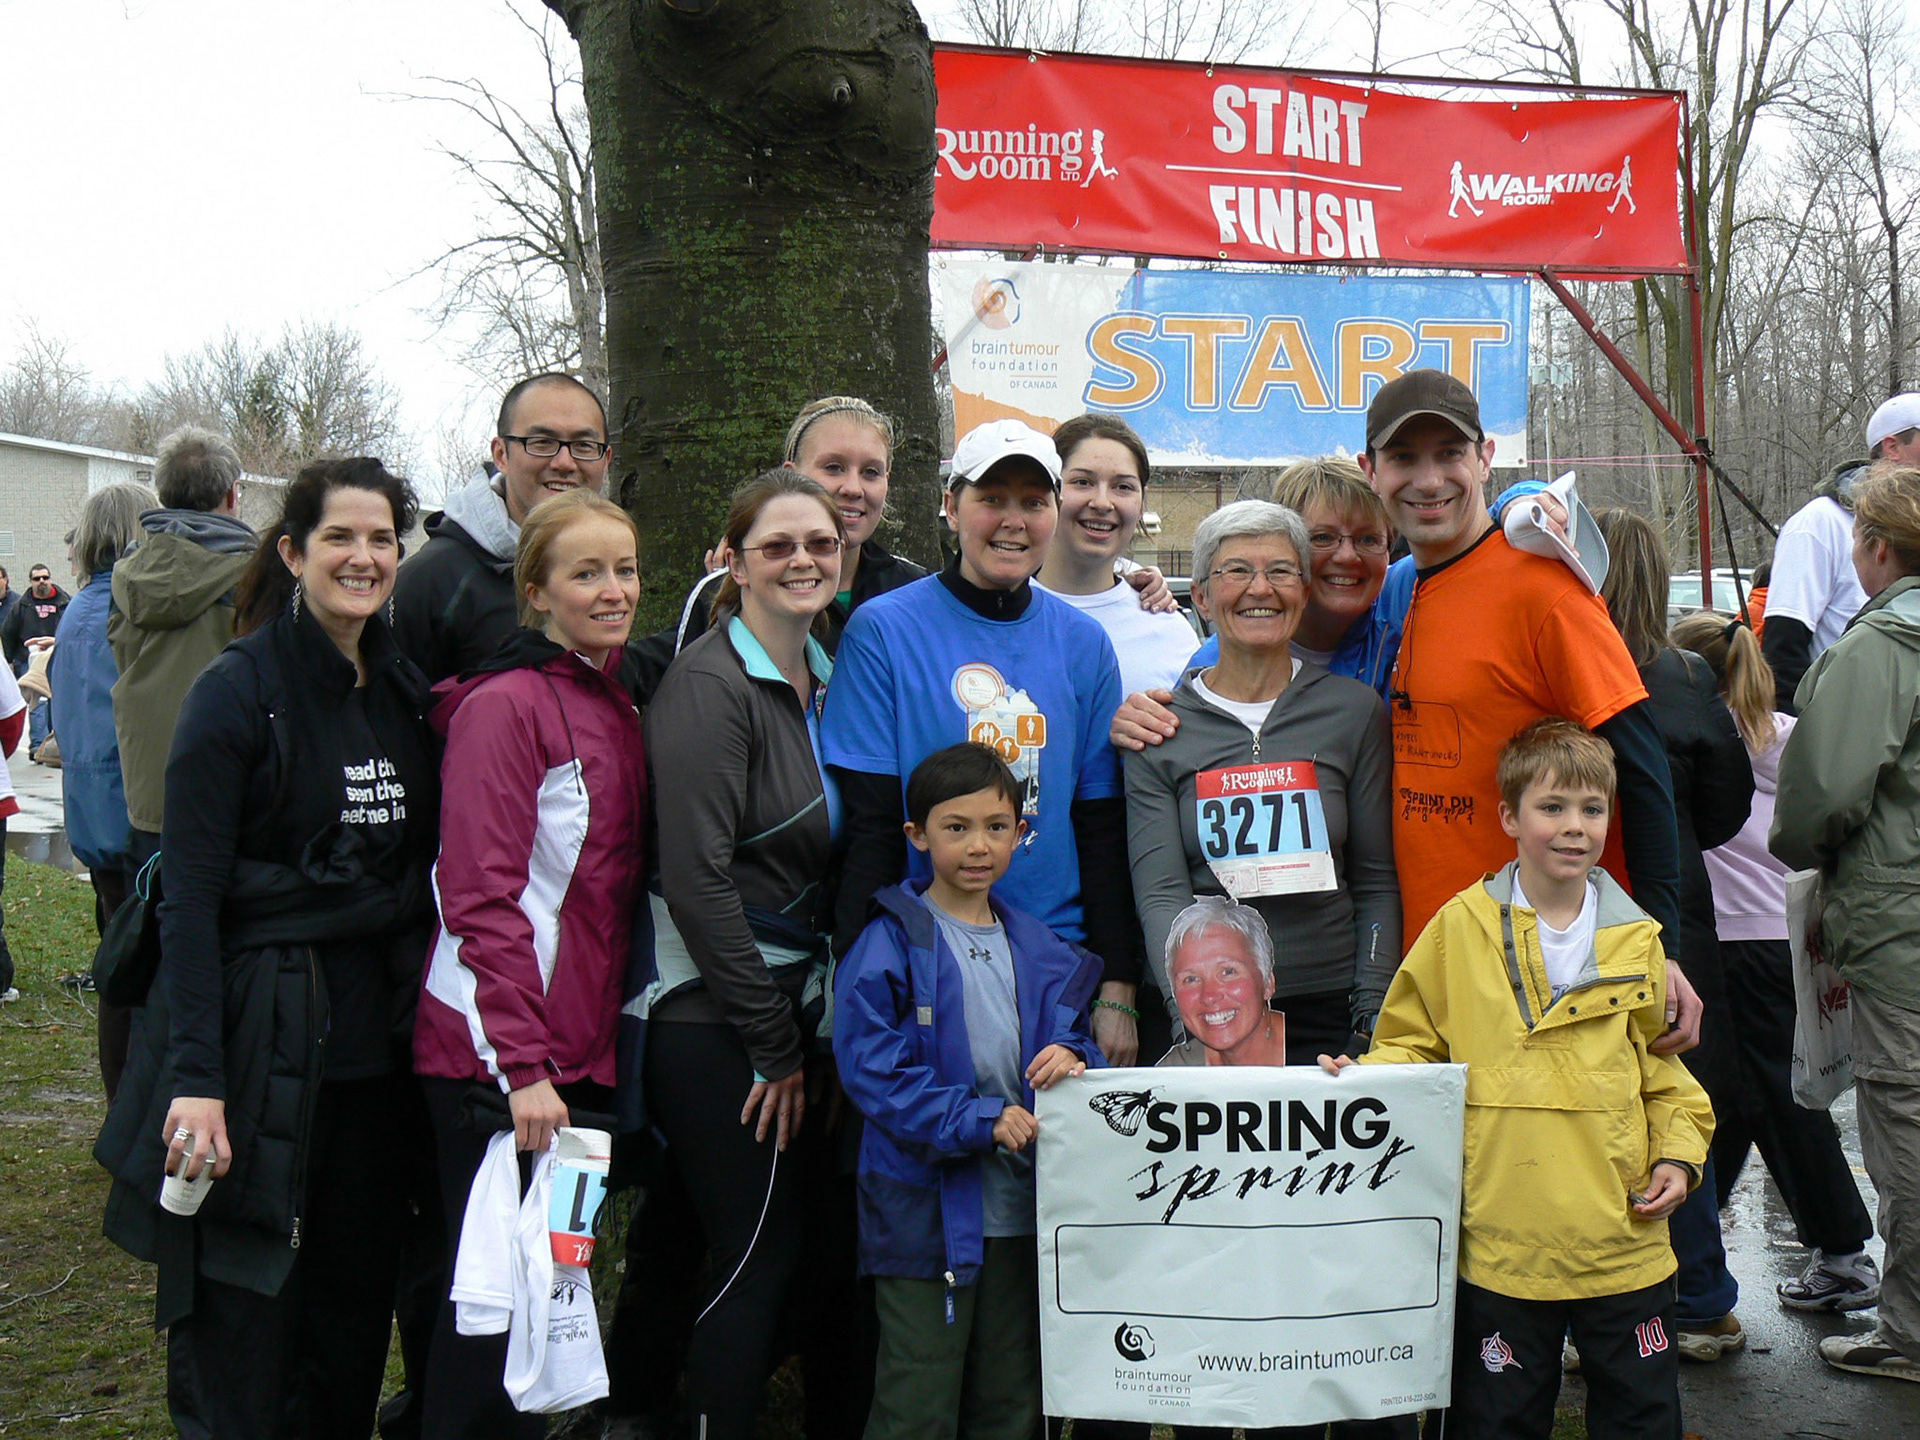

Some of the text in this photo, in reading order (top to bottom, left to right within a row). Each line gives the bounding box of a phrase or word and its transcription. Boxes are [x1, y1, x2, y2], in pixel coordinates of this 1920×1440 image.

[1212, 84, 1369, 167] START
[1468, 172, 1615, 201] WALKING
[1502, 193, 1552, 206] ROOM
[1209, 184, 1381, 259] FINISH
[972, 358, 1058, 371] foundation
[1082, 310, 1512, 413] START
[1009, 380, 1058, 389] OF CANADA
[377, 757, 397, 778] th
[1229, 767, 1285, 790] Running
[376, 779, 406, 801] the
[1407, 791, 1474, 809] SPRINT DU
[340, 804, 367, 824] eet
[392, 800, 406, 821] in
[1203, 792, 1312, 859] 3271
[1145, 1097, 1391, 1153] SPRING
[1128, 1136, 1415, 1225] sprint
[1634, 1316, 1669, 1358] 10
[1198, 1343, 1415, 1374] www.braintumour.ca
[1114, 1366, 1192, 1383] braintumour
[1115, 1381, 1191, 1395] foundation
[1159, 1399, 1191, 1408] CANADA
